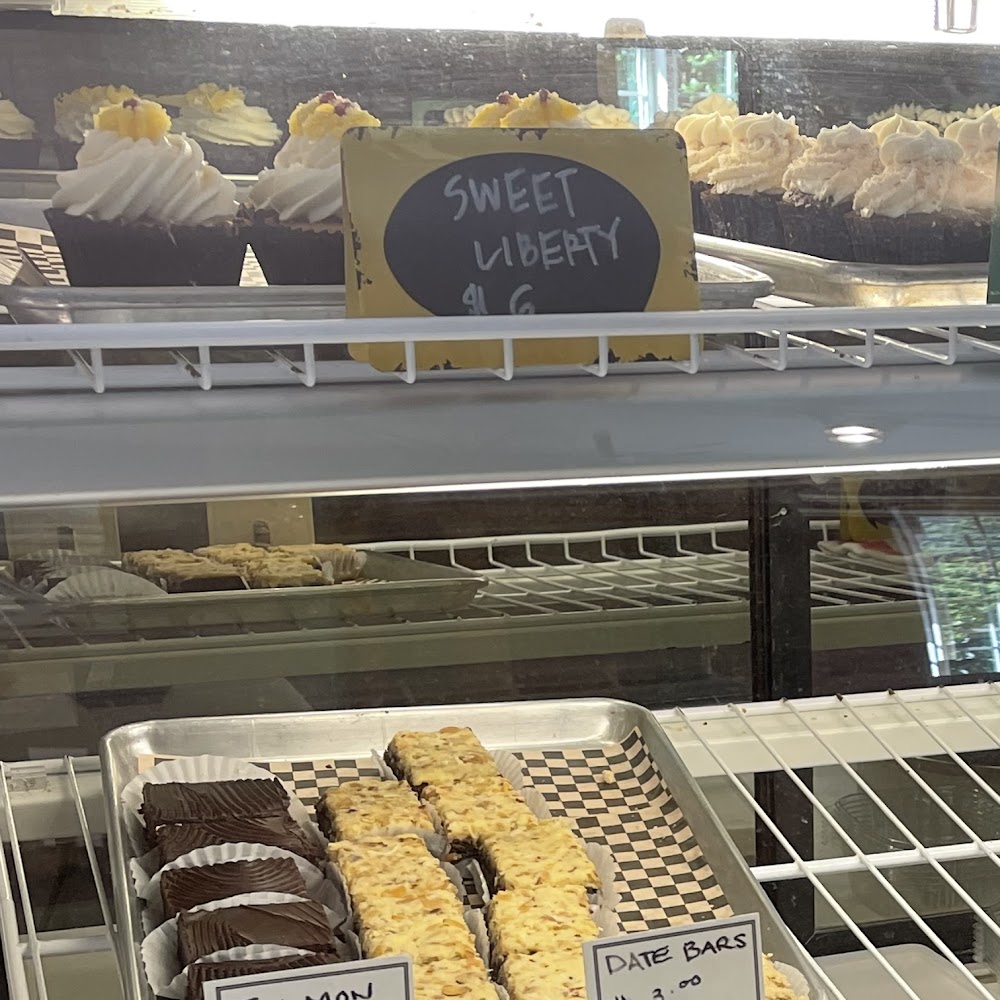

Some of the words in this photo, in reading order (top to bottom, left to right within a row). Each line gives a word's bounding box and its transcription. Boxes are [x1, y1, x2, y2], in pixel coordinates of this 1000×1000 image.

[444, 168, 578, 221] SWEET
[474, 217, 622, 271] LIBERTY
[605, 945, 673, 975] DATE
[683, 933, 747, 962] BARS
